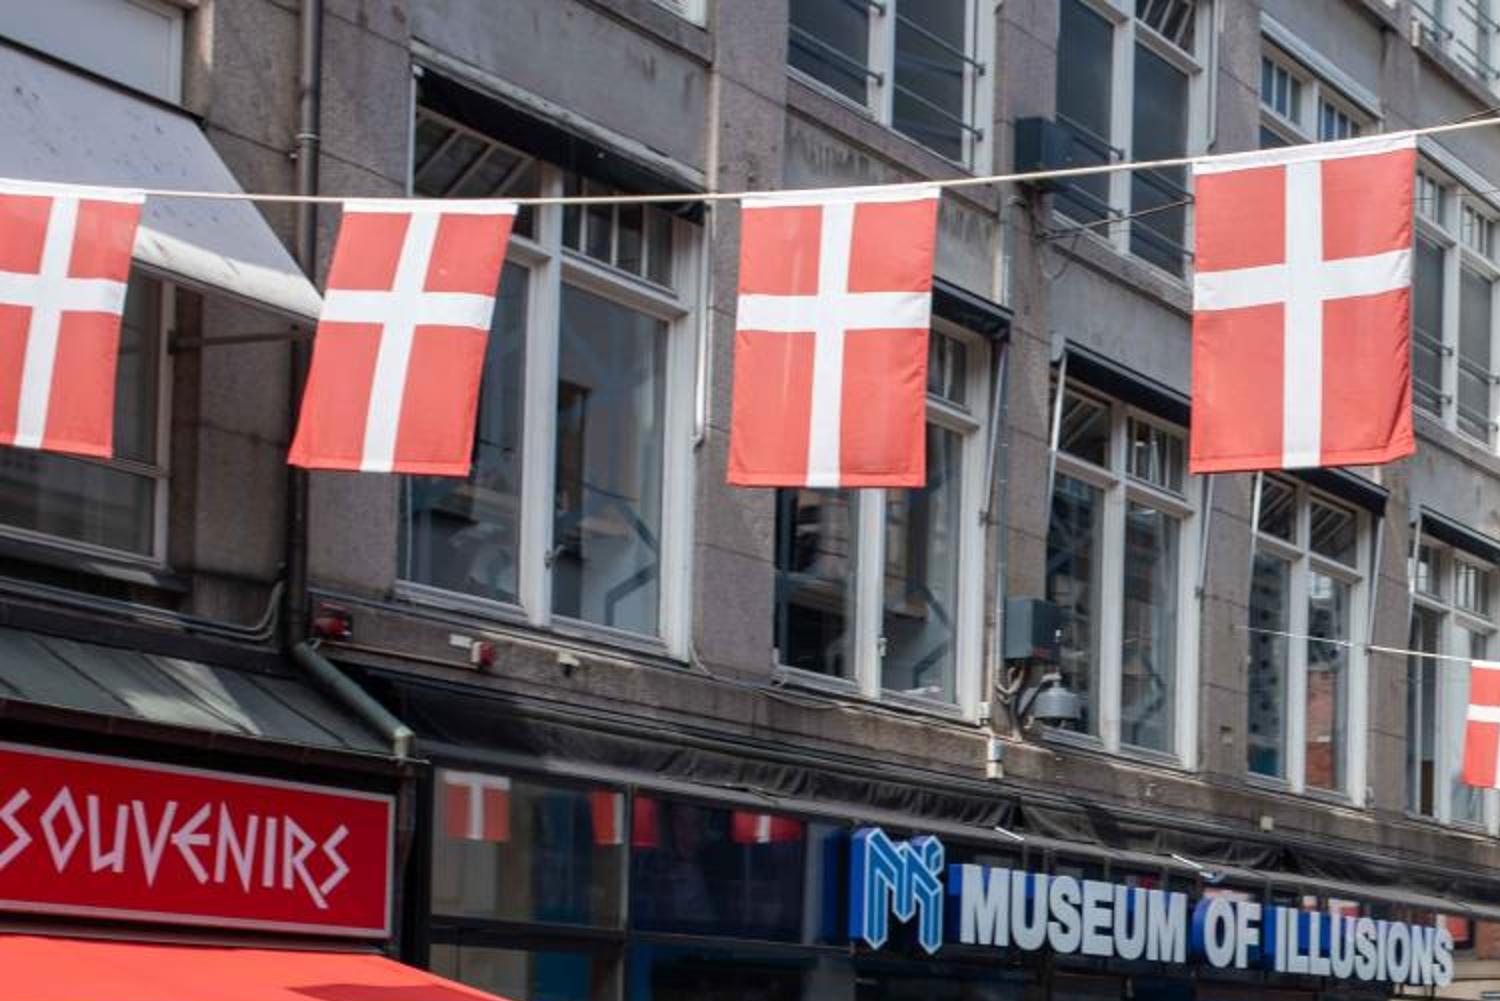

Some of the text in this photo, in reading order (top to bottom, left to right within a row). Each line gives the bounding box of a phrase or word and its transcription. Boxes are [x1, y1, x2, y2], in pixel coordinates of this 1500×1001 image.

[0, 784, 351, 910] SOUVENIRS
[959, 863, 1455, 988] MUSEUM OF ILLUSIONS
